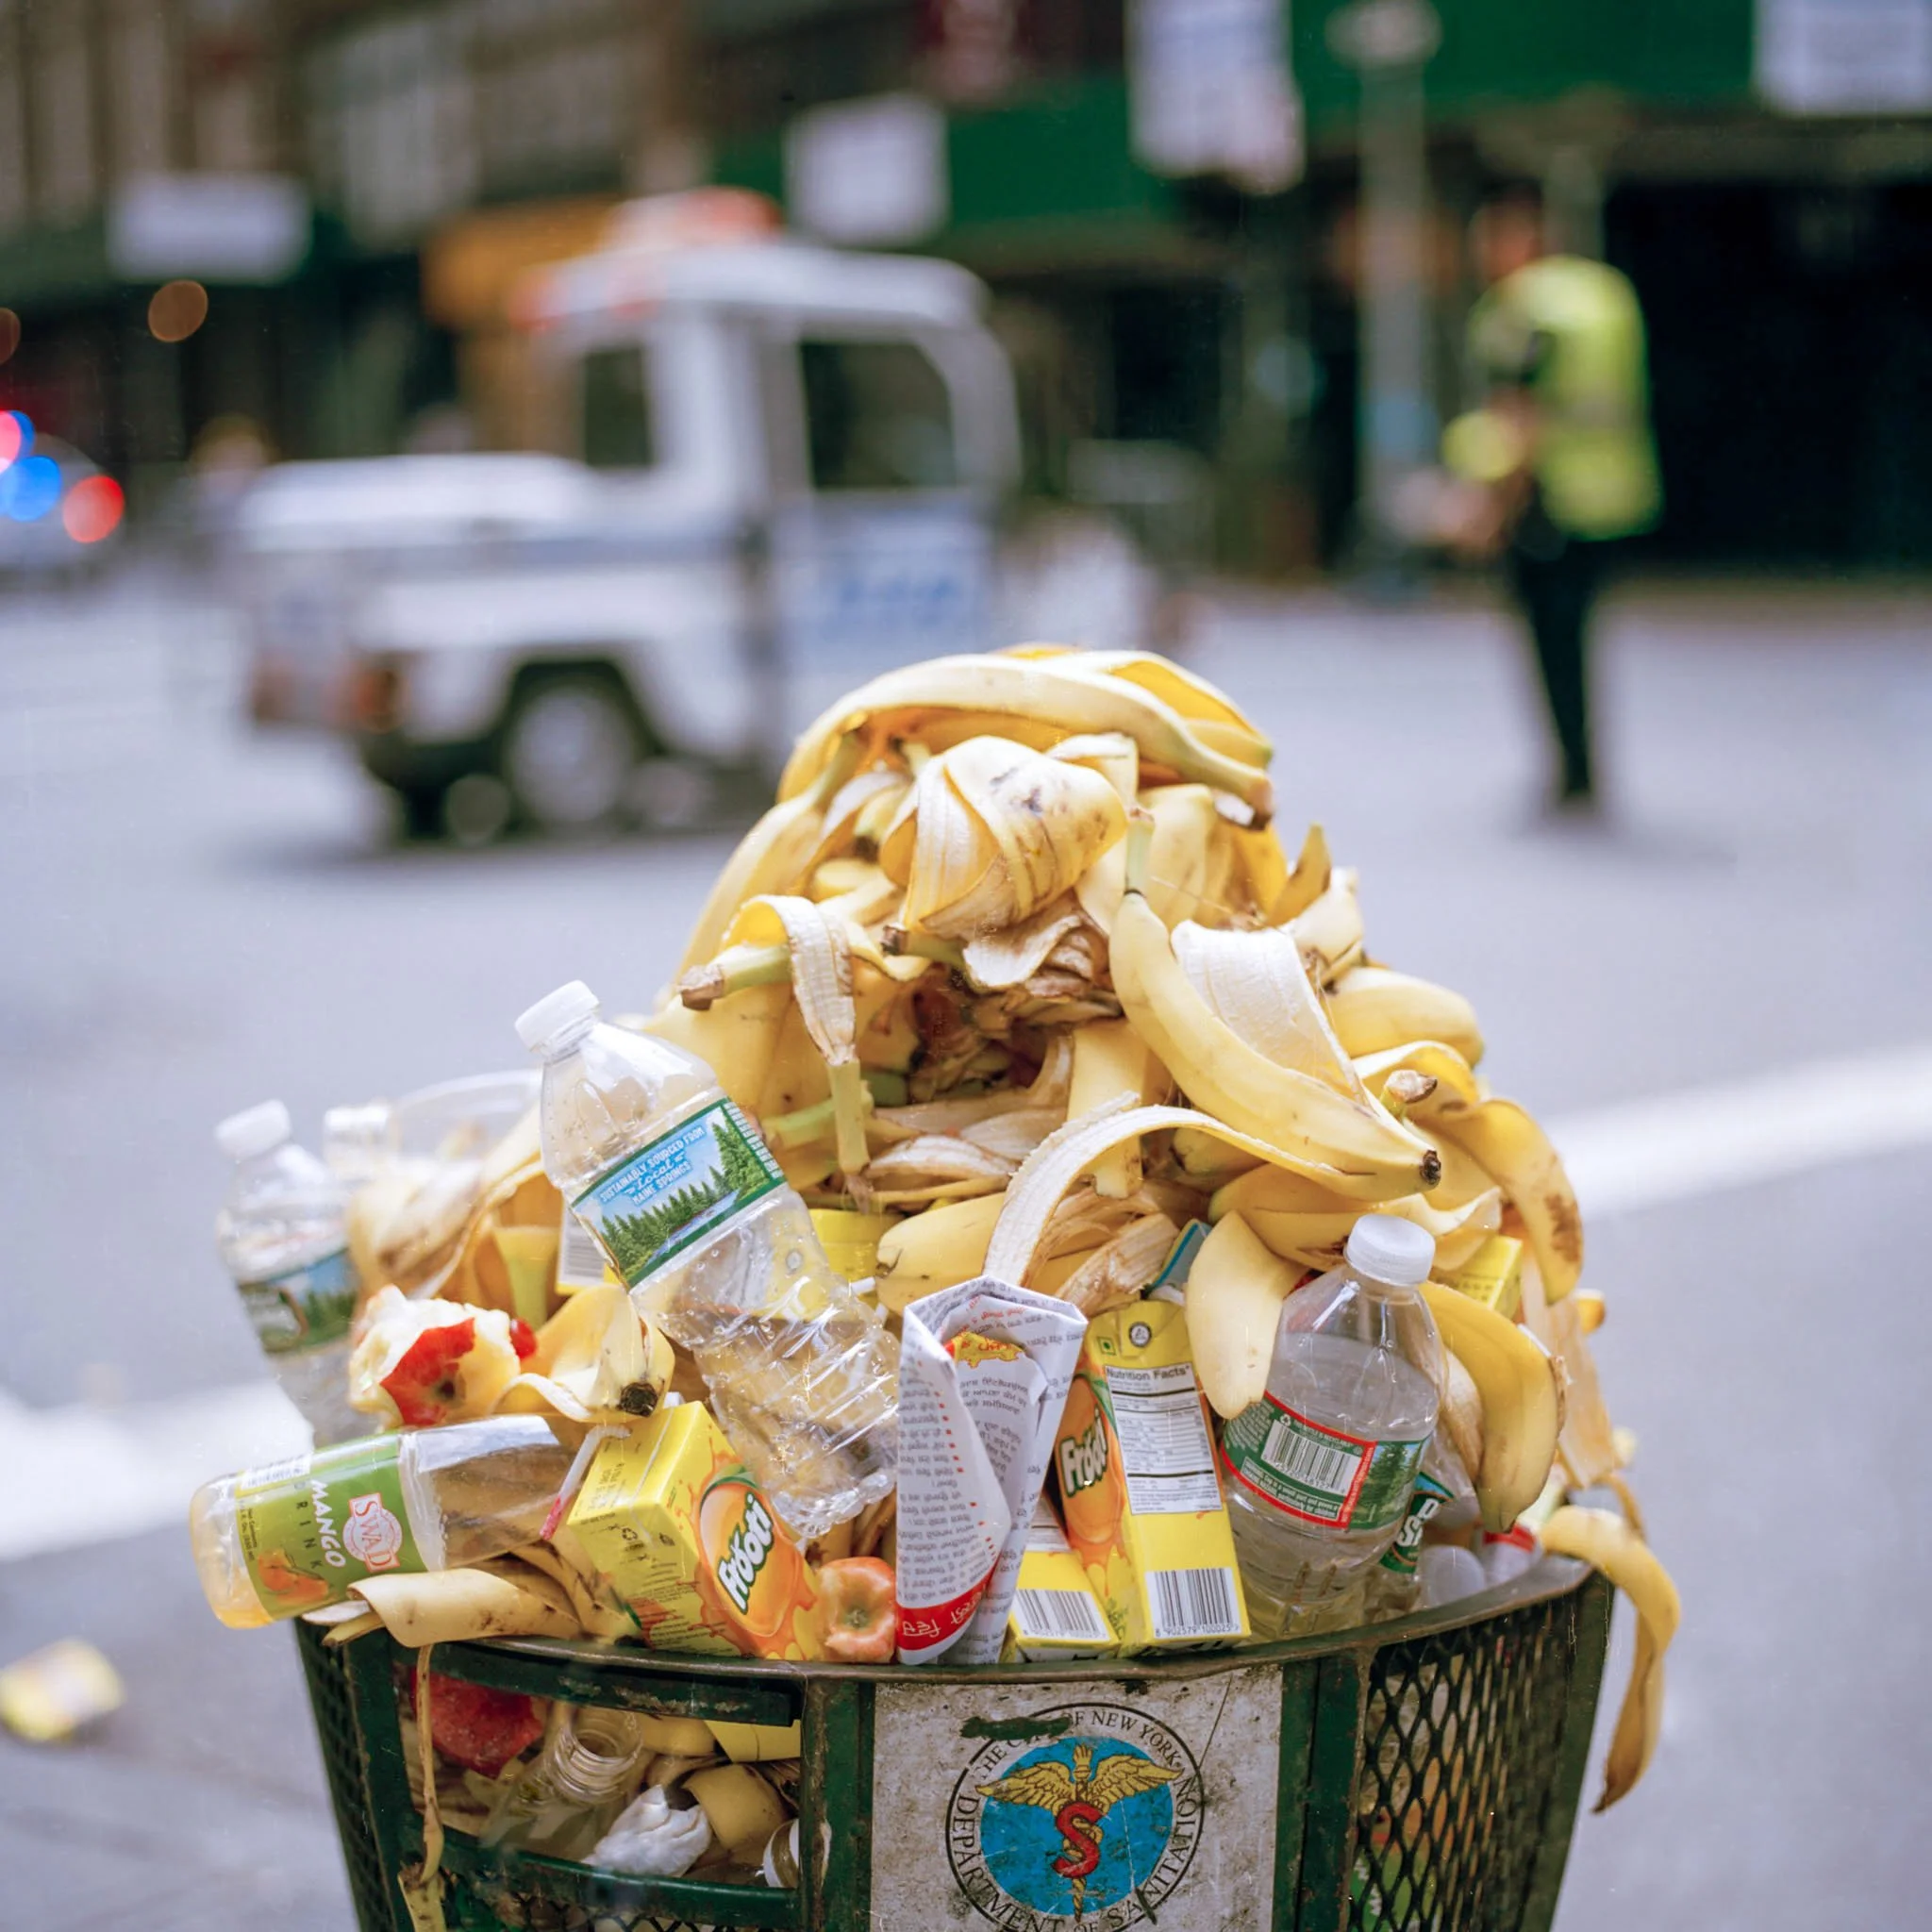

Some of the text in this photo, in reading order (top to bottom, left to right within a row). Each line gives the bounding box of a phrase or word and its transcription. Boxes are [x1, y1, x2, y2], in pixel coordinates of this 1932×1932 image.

[649, 1141, 684, 1168] SOURCED
[685, 1126, 705, 1145] FROM
[634, 1162, 691, 1204] MAINE SPRINGS
[1107, 1369, 1150, 1381] Nutrition
[294, 1482, 323, 1569] DRINK
[311, 1480, 346, 1567] MANGO
[354, 1500, 393, 1567] SWAD
[718, 1492, 773, 1613] Frooti
[1091, 1710, 1138, 1731] NEW
[1140, 1724, 1180, 1767] YORK
[952, 1794, 1067, 1932] DEPARTMENT
[1107, 1774, 1197, 1927] SANITATION
